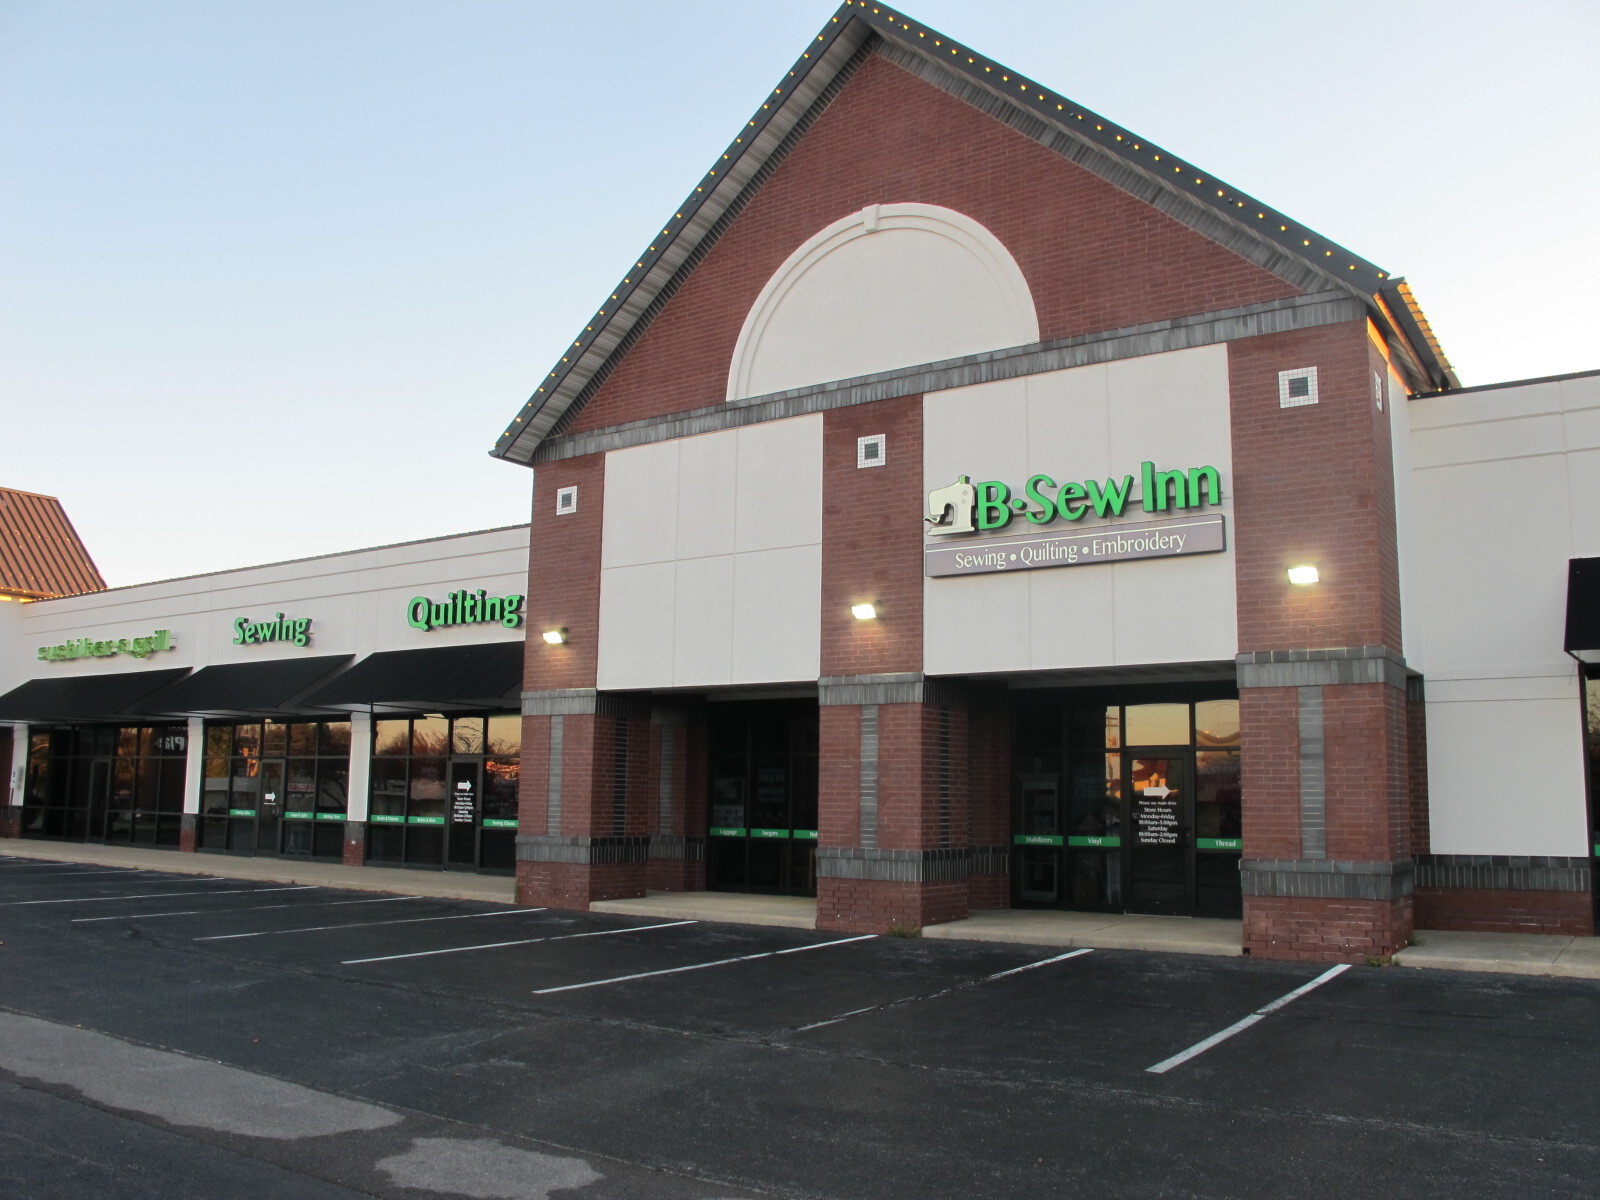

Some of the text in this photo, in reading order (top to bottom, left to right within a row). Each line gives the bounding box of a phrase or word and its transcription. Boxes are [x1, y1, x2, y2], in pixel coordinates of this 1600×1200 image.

[1140, 460, 1222, 513] Inn
[954, 533, 1186, 570] Sewing Quilting Embroidery
[407, 588, 526, 632] Quilting
[233, 611, 313, 648] Sewing
[1087, 837, 1102, 846] Vinyl
